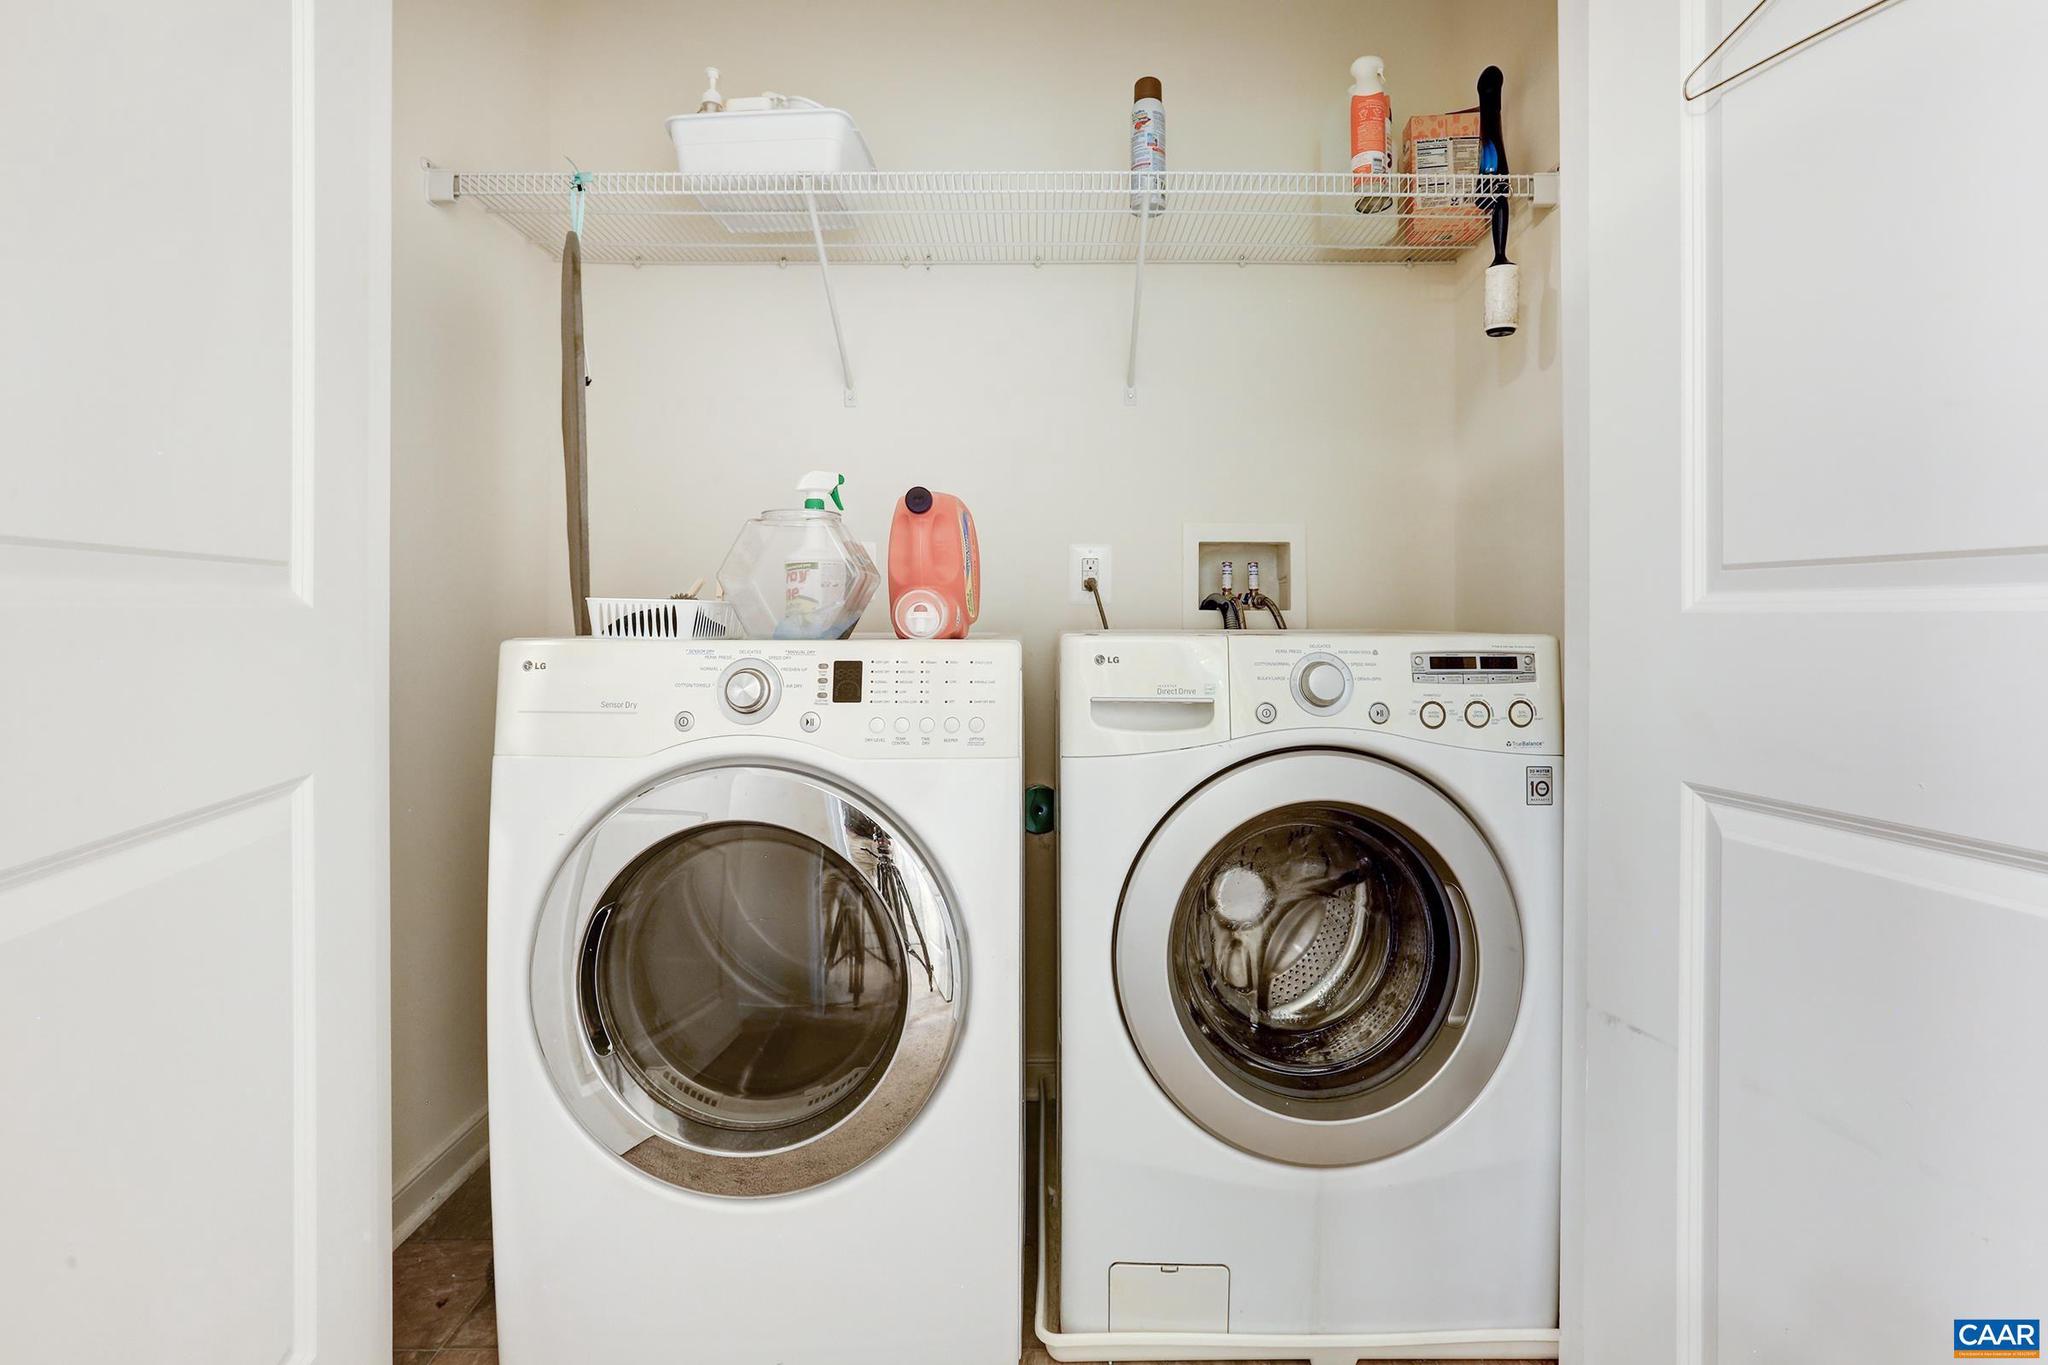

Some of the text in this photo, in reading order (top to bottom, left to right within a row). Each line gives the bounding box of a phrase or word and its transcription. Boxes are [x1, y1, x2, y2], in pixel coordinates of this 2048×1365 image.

[1107, 656, 1120, 664] LG
[534, 662, 547, 670] LG
[1156, 687, 1178, 696] Direct
[1178, 687, 1197, 696] Drive
[600, 700, 638, 710] Sensor Dry
[1530, 780, 1550, 797] 10
